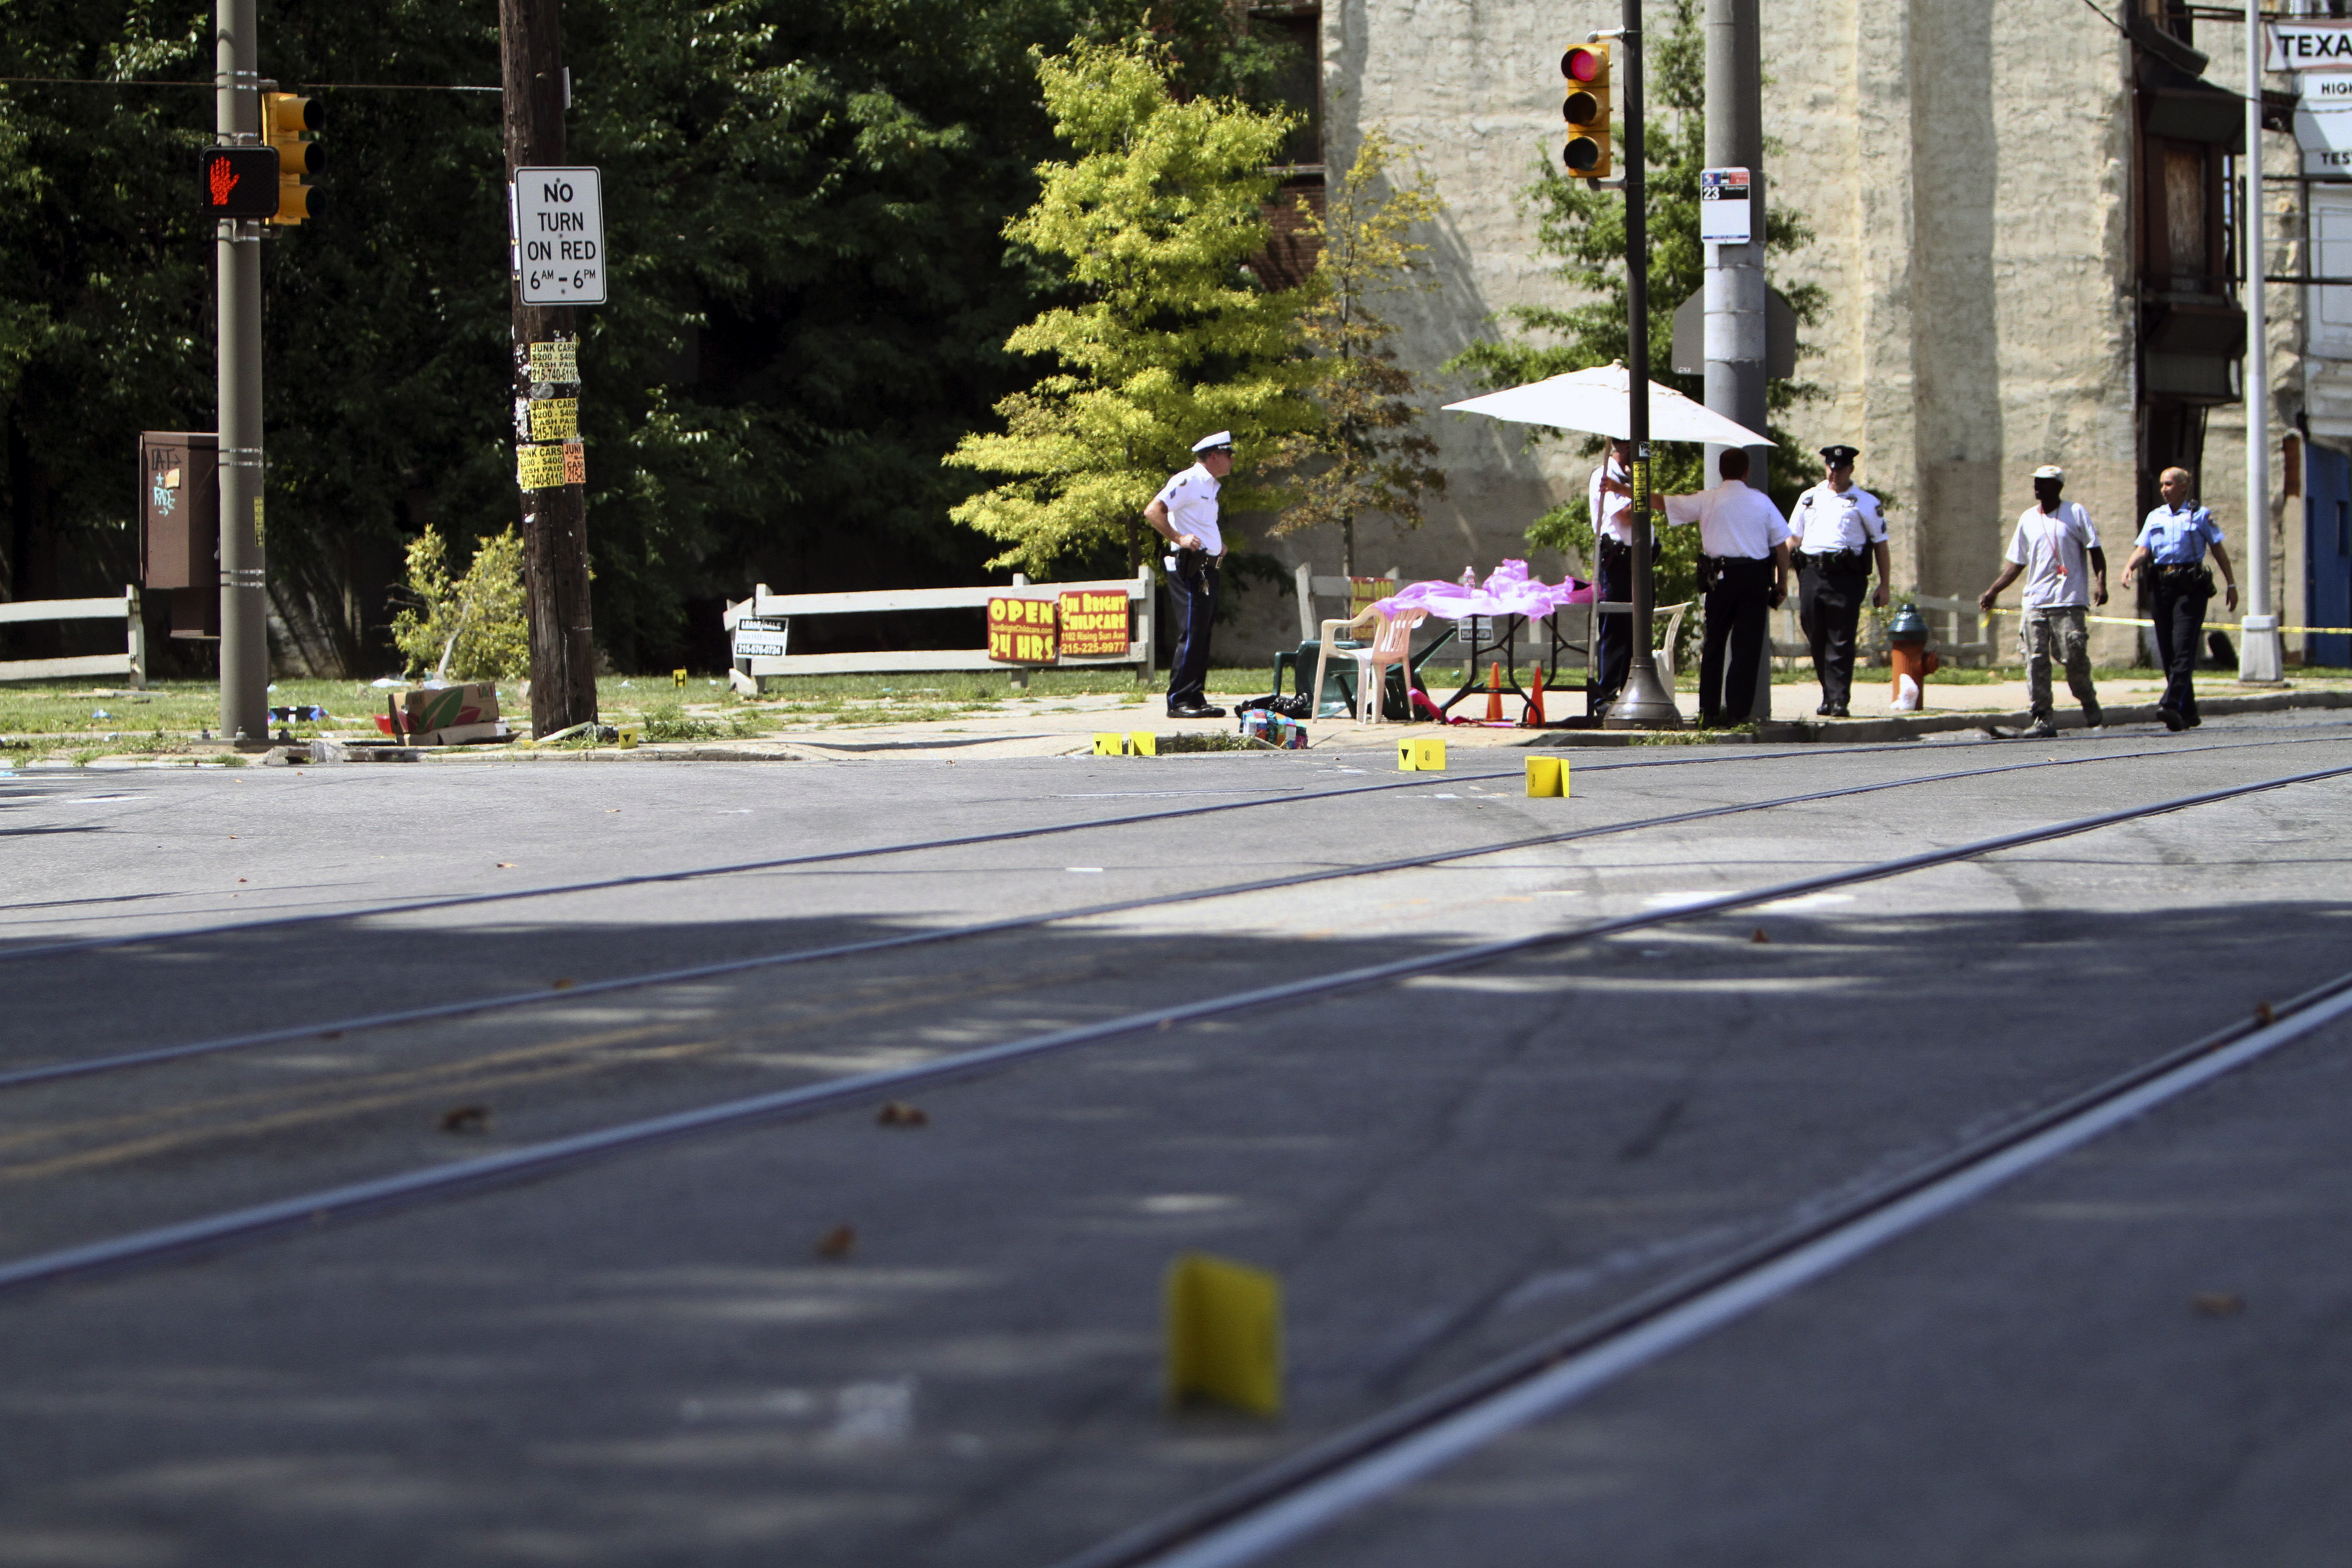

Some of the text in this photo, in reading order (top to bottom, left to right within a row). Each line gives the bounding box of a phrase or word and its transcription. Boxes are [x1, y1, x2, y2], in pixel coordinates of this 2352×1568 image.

[2278, 34, 2352, 57] TEXA
[2321, 152, 2352, 165] TES
[544, 183, 574, 203] NO
[1703, 186, 1720, 200] 23
[538, 212, 583, 231] TURN
[527, 240, 596, 261] ON RED
[532, 343, 575, 352] JUNK CARS
[532, 399, 576, 411] JUNK CARS
[532, 410, 552, 419] $200
[560, 408, 576, 417] $400
[533, 418, 557, 427] CASH
[534, 424, 577, 440] 215-740-6116
[520, 447, 562, 459] JUNK CARS
[565, 444, 582, 455] JUNK
[542, 456, 563, 465] $400
[989, 598, 1054, 625] OPEN
[1060, 630, 1126, 642] 1102 Rising Sun Ave
[990, 631, 1054, 661] 24 HRS
[1061, 641, 1126, 655] 215-225-9977
